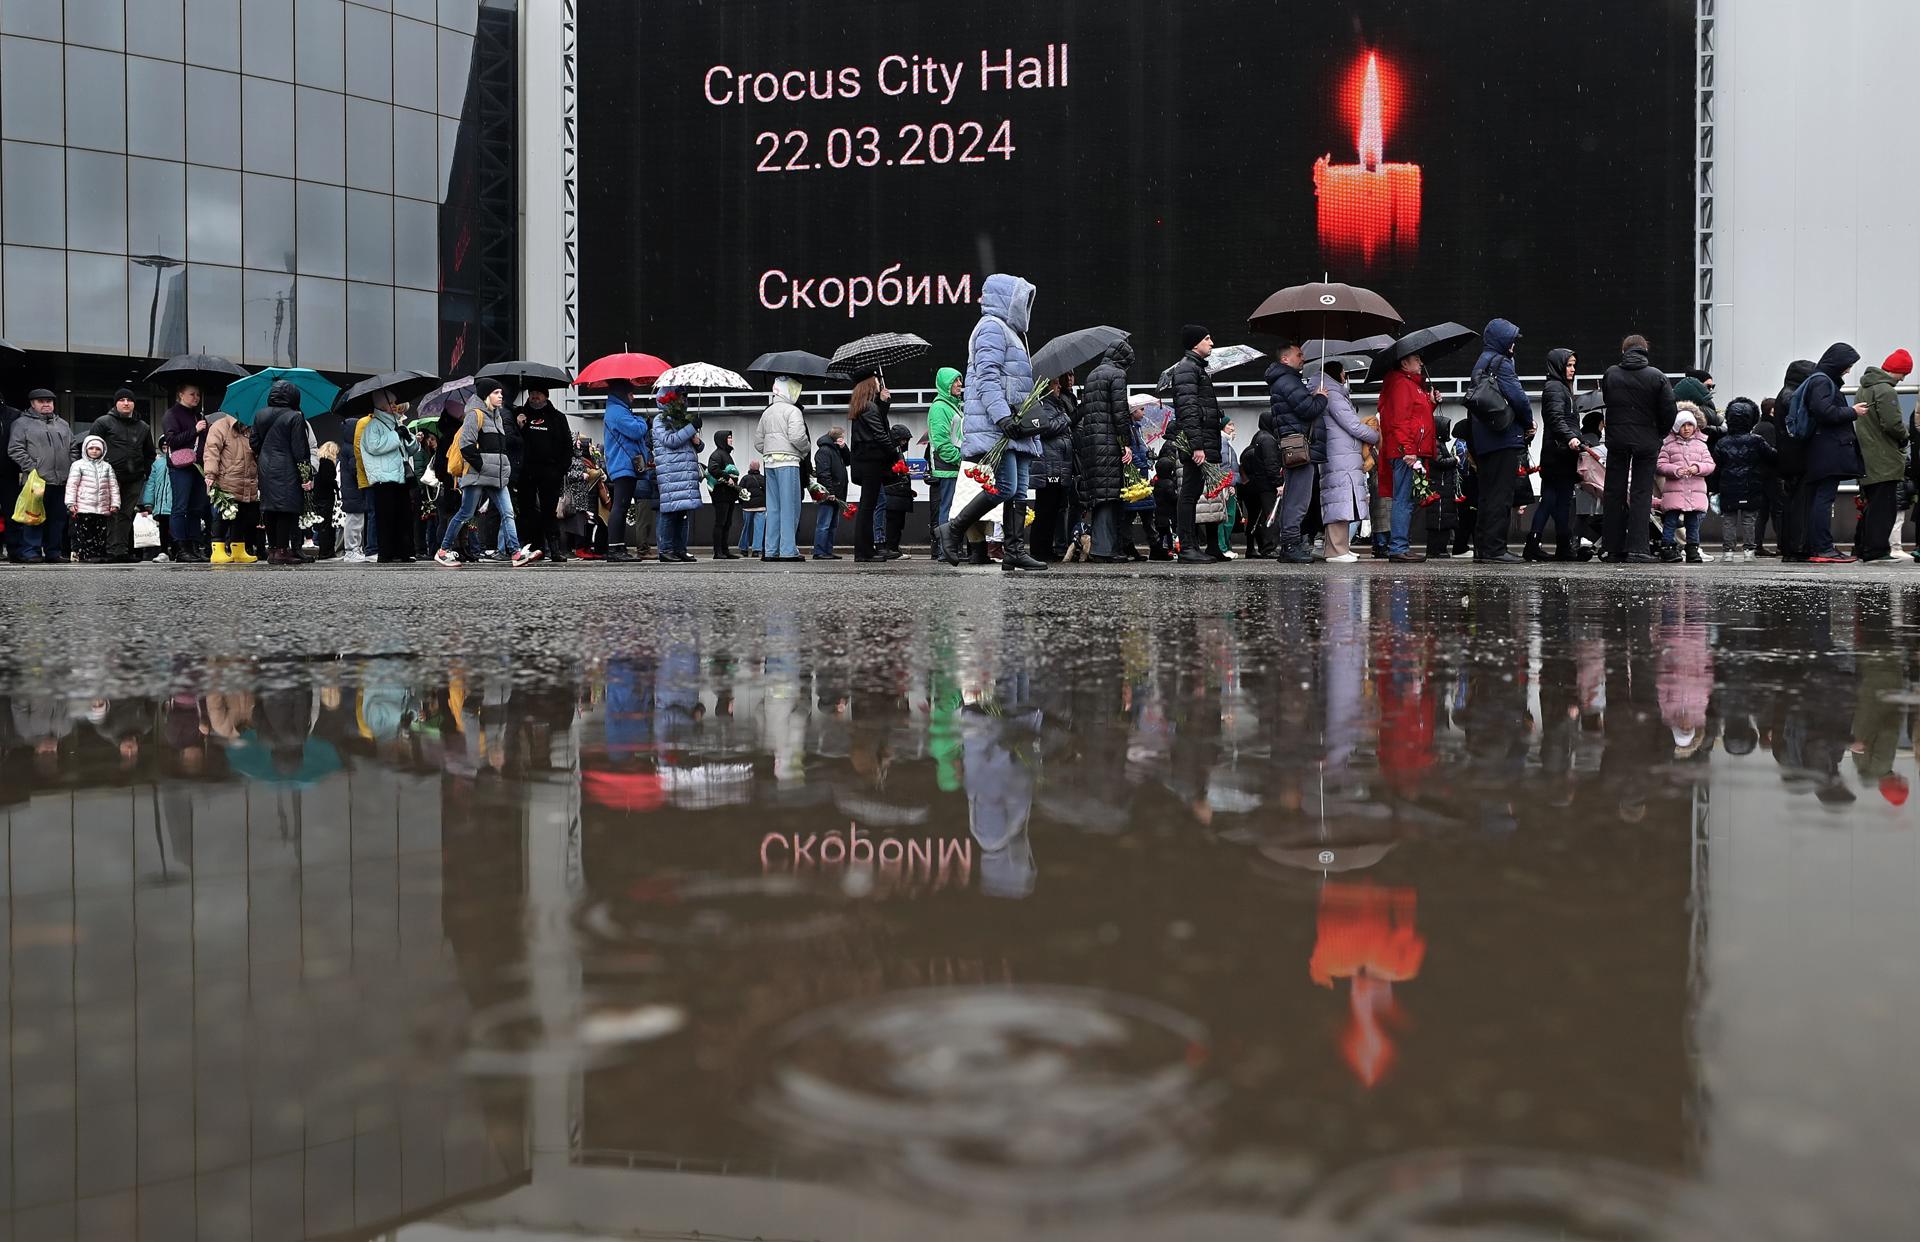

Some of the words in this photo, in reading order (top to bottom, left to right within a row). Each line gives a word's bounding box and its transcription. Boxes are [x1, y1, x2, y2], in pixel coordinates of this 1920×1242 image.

[704, 65, 862, 105] Crocus
[877, 54, 963, 105] City
[980, 43, 1068, 91] Hall
[755, 119, 1016, 172] 22.03.2024
